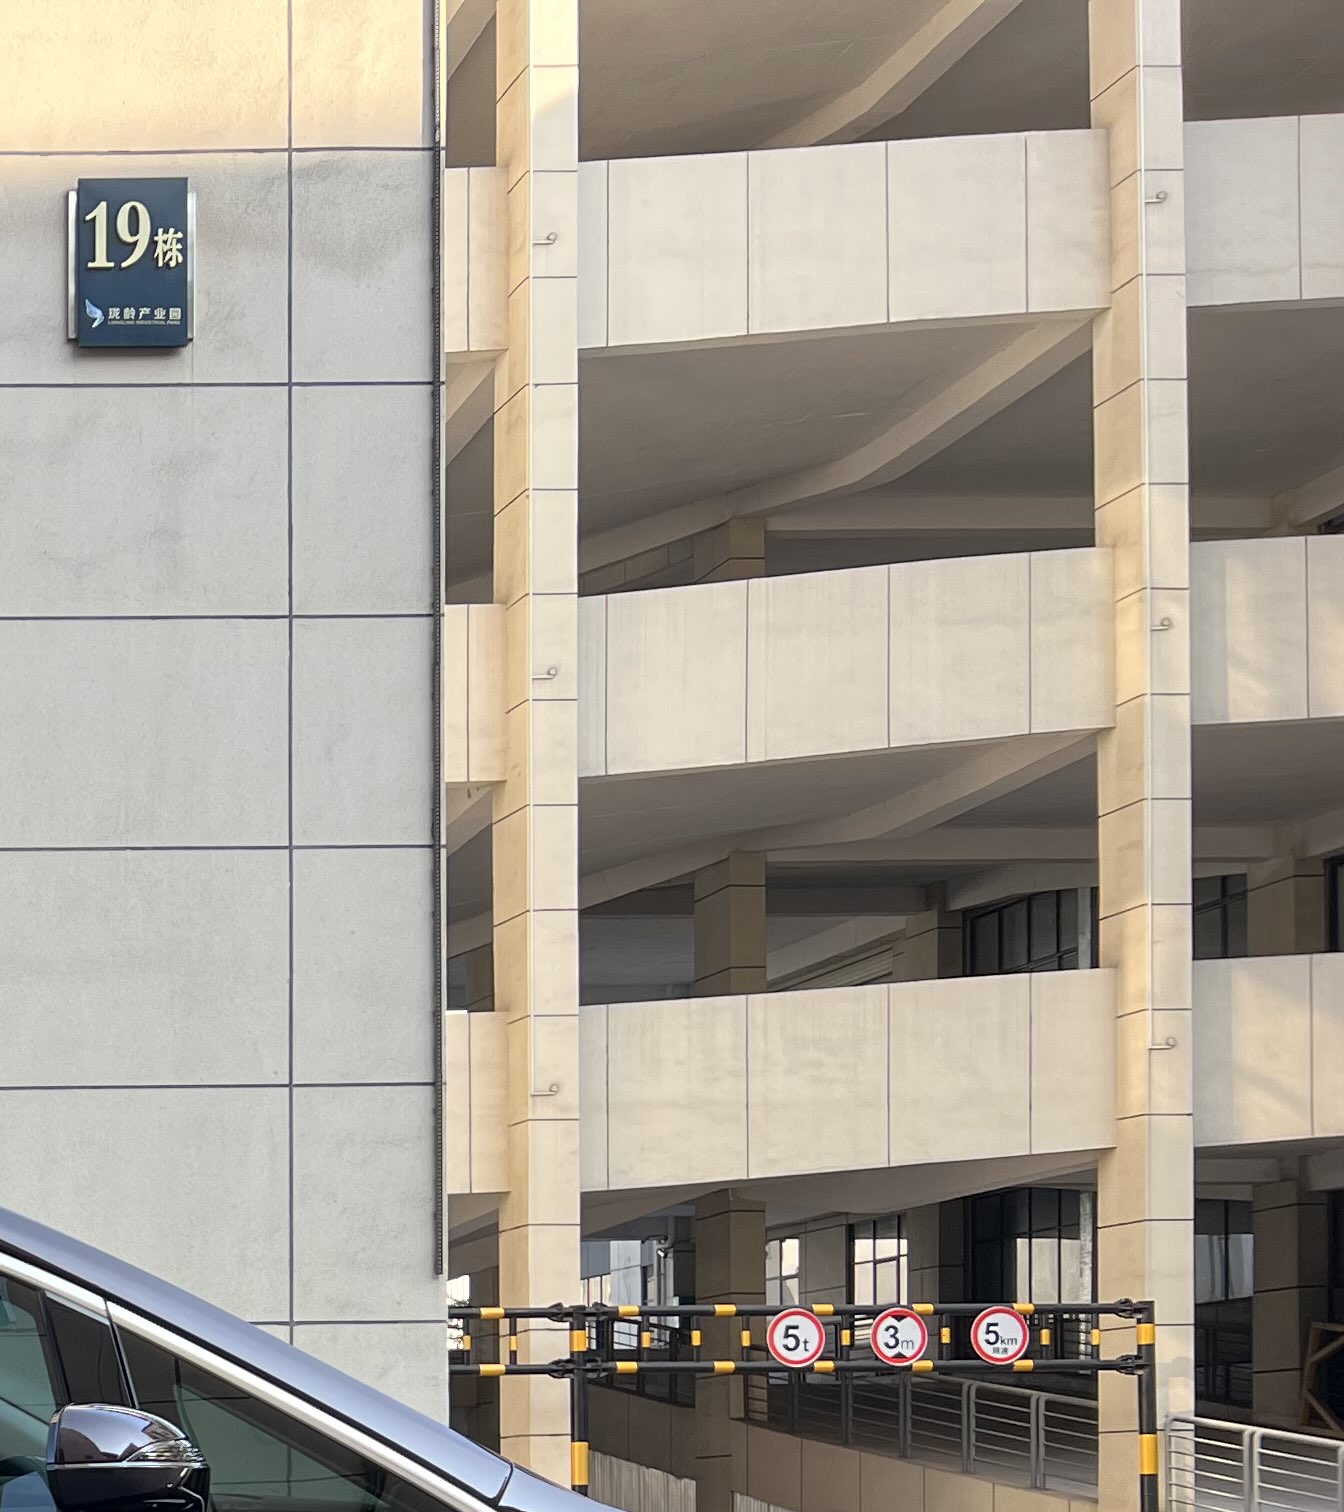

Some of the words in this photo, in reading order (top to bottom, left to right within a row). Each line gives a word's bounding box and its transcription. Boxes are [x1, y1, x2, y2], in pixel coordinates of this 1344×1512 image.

[84, 200, 184, 269] 19栋
[782, 1325, 810, 1352] 5t
[883, 1325, 915, 1350] 3m
[984, 1322, 1018, 1346] 5km
